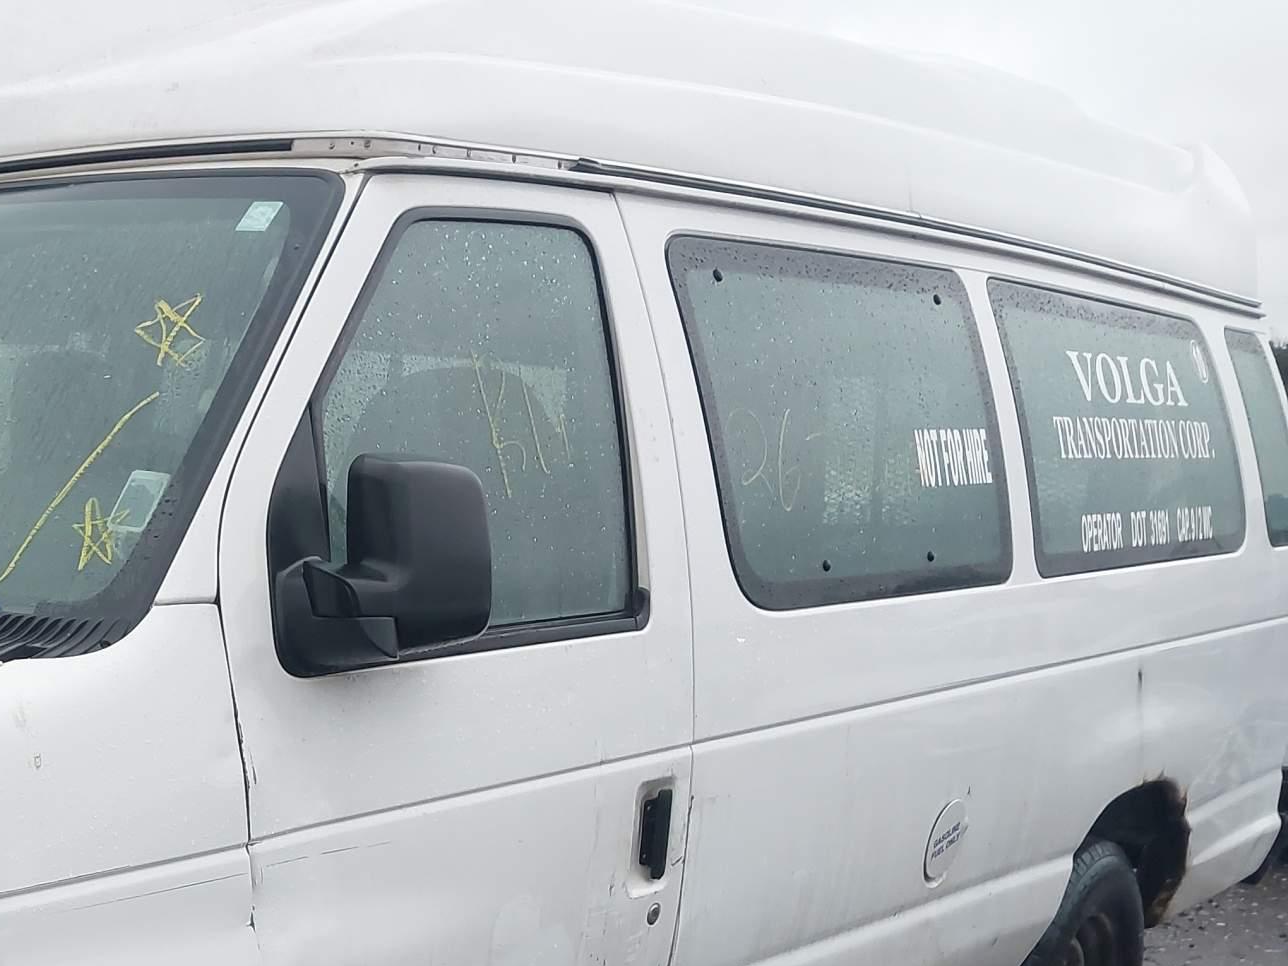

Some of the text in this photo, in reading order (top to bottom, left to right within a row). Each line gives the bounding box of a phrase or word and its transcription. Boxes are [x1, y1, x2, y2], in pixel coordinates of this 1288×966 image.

[1066, 350, 1188, 407] VOLGA
[914, 428, 993, 488] NOT FOR HIRE
[1053, 416, 1216, 459] TRANSPORTATION CORP.
[1081, 511, 1124, 552] OPERATOR
[1130, 510, 1147, 547] DOT
[930, 845, 945, 862] FUEL
[933, 821, 961, 849] GASOLINE
